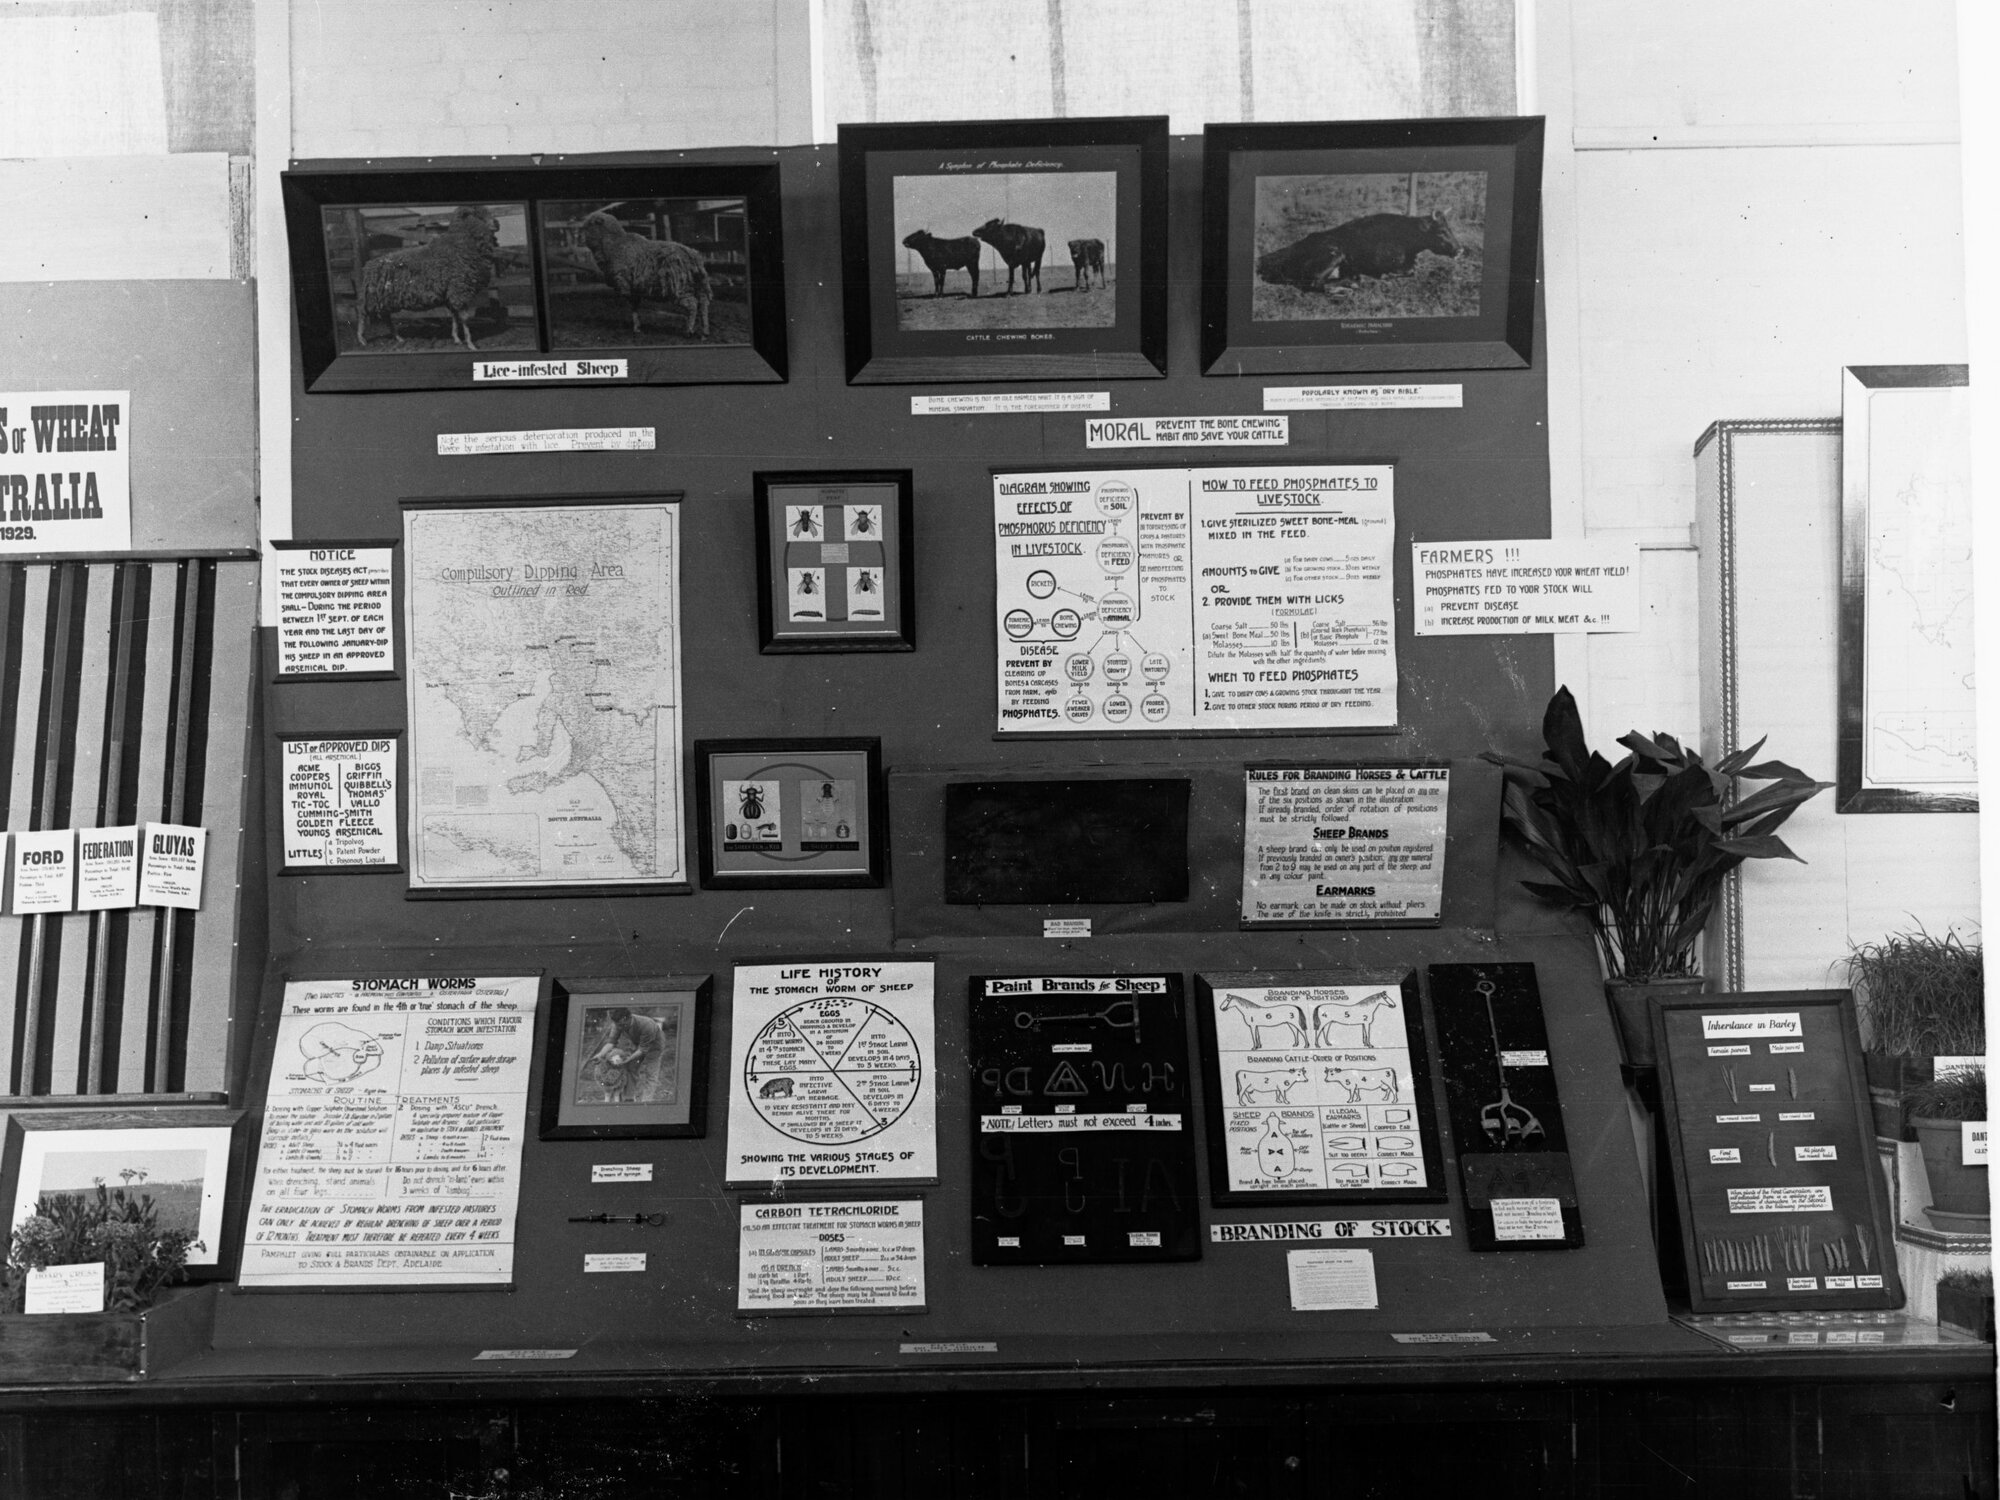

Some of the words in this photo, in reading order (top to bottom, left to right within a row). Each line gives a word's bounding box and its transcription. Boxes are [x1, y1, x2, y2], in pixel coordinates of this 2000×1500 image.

[483, 362, 567, 377] Lice-infested
[577, 362, 619, 376] Sheep
[12, 428, 26, 453] OF
[31, 404, 120, 453] WHEAT
[1156, 420, 1196, 429] PREVENT
[1200, 419, 1215, 429] THE
[1218, 419, 1239, 429] BONE
[1242, 418, 1280, 428] CHEWING
[1090, 422, 1150, 442] MORAL
[1156, 432, 1179, 441] HABIT
[1182, 431, 1199, 441] AND
[1201, 431, 1224, 441] SAVE
[1227, 431, 1249, 440] YOUR
[1252, 430, 1284, 440] CATTLE
[1000, 483, 1046, 493] DIAGRAM
[1050, 481, 1090, 494] SHOWING
[1203, 480, 1227, 491] HOW
[1233, 479, 1246, 489] TO
[1250, 479, 1278, 490] FEED
[1284, 478, 1359, 491] PHOSPHATES
[1364, 478, 1377, 489] TO
[1017, 502, 1057, 513] EFFECTS
[1061, 501, 1072, 512] OF
[999, 522, 1056, 535] PHOSPHORUS
[1060, 520, 1106, 534] DEFICIENCY
[310, 550, 356, 560] NOTICE
[1012, 544, 1021, 555] IN
[1025, 543, 1086, 555] LIVESTOCK.
[1421, 549, 1493, 564] FARMERS
[1505, 548, 1520, 561] !!!
[298, 568, 318, 576] STOCK
[320, 568, 351, 576] DISEASES
[442, 565, 513, 584] Compulsory
[524, 563, 577, 581] Dipping
[591, 562, 623, 577] Area
[1426, 569, 1482, 579] PHOSPHATES
[1487, 569, 1508, 577] HAVE
[1511, 568, 1552, 577] INCREASED
[1554, 568, 1572, 576] YOUR
[1575, 567, 1600, 576] WHEAT
[1603, 566, 1629, 576] YIELD!
[493, 584, 540, 596] Outlined
[545, 586, 556, 595] in
[565, 583, 588, 595] Red
[295, 592, 335, 600] COMPULSORY
[1441, 602, 1479, 611] PREVENT
[1484, 601, 1519, 610] DISEASE
[1208, 672, 1237, 683] WHEN
[1243, 672, 1255, 681] TO
[1259, 671, 1287, 681] FEED
[1292, 669, 1358, 681] PHOSPHATES
[288, 743, 309, 754] LIST
[320, 742, 368, 752] APPROVED
[372, 741, 390, 752] DIPS
[298, 764, 320, 772] ACME
[355, 763, 381, 771] BIGGS
[290, 773, 330, 781] COOPERS
[346, 772, 382, 780] GRIFFIN
[1249, 770, 1278, 780] RULES
[1283, 771, 1299, 780] FOR
[1304, 769, 1350, 780] BRANDING
[1356, 769, 1391, 779] HORSES
[1396, 771, 1405, 779] &
[1410, 769, 1447, 779] CATTLE
[289, 782, 333, 790] IMMUNOL
[351, 799, 380, 807] VALLO
[339, 818, 374, 826] FLEECE
[298, 829, 330, 837] YOUNGS
[336, 828, 383, 837] ARSENICAL
[1313, 827, 1345, 839] SHEEP
[1349, 827, 1388, 838] BRANDS
[83, 840, 133, 860] FEDERATION
[153, 834, 195, 856] GLUYAS
[23, 850, 64, 865] FORD
[288, 850, 322, 859] LITTLES
[1316, 885, 1375, 896] EARMARKS
[781, 970, 811, 979] LIFE
[819, 968, 881, 979] HISTORY
[352, 979, 418, 990] STOMACH
[428, 978, 476, 989] WORMS
[775, 986, 818, 995] STOMACH
[826, 985, 856, 994] WORM
[861, 984, 875, 992] OF
[880, 983, 914, 992] SHEEP
[992, 980, 1032, 993] Paint
[1042, 979, 1095, 991] Brands
[1115, 979, 1160, 992] Sheep
[1708, 1020, 1753, 1030] Inheritance
[1770, 1020, 1796, 1032] Barley
[1018, 1118, 1053, 1128] Letters
[1059, 1117, 1077, 1128] must
[1084, 1116, 1097, 1127] not
[1103, 1116, 1136, 1127] exceed
[1144, 1116, 1154, 1126] 4
[741, 1154, 783, 1164] SHOWING
[788, 1154, 806, 1162] THE
[811, 1154, 850, 1162] VARIOUS
[856, 1153, 894, 1161] STAGES
[900, 1152, 914, 1160] OF
[781, 1166, 795, 1176] ITS
[799, 1165, 878, 1175] DEVELOPMENT.
[756, 1208, 801, 1218] CARBON
[809, 1206, 898, 1217] TETRACHLORIDE
[1220, 1223, 1322, 1241] BRANDING
[1335, 1222, 1358, 1237] OF
[1373, 1220, 1442, 1236] STOCK
[819, 1234, 844, 1242] DOSES
